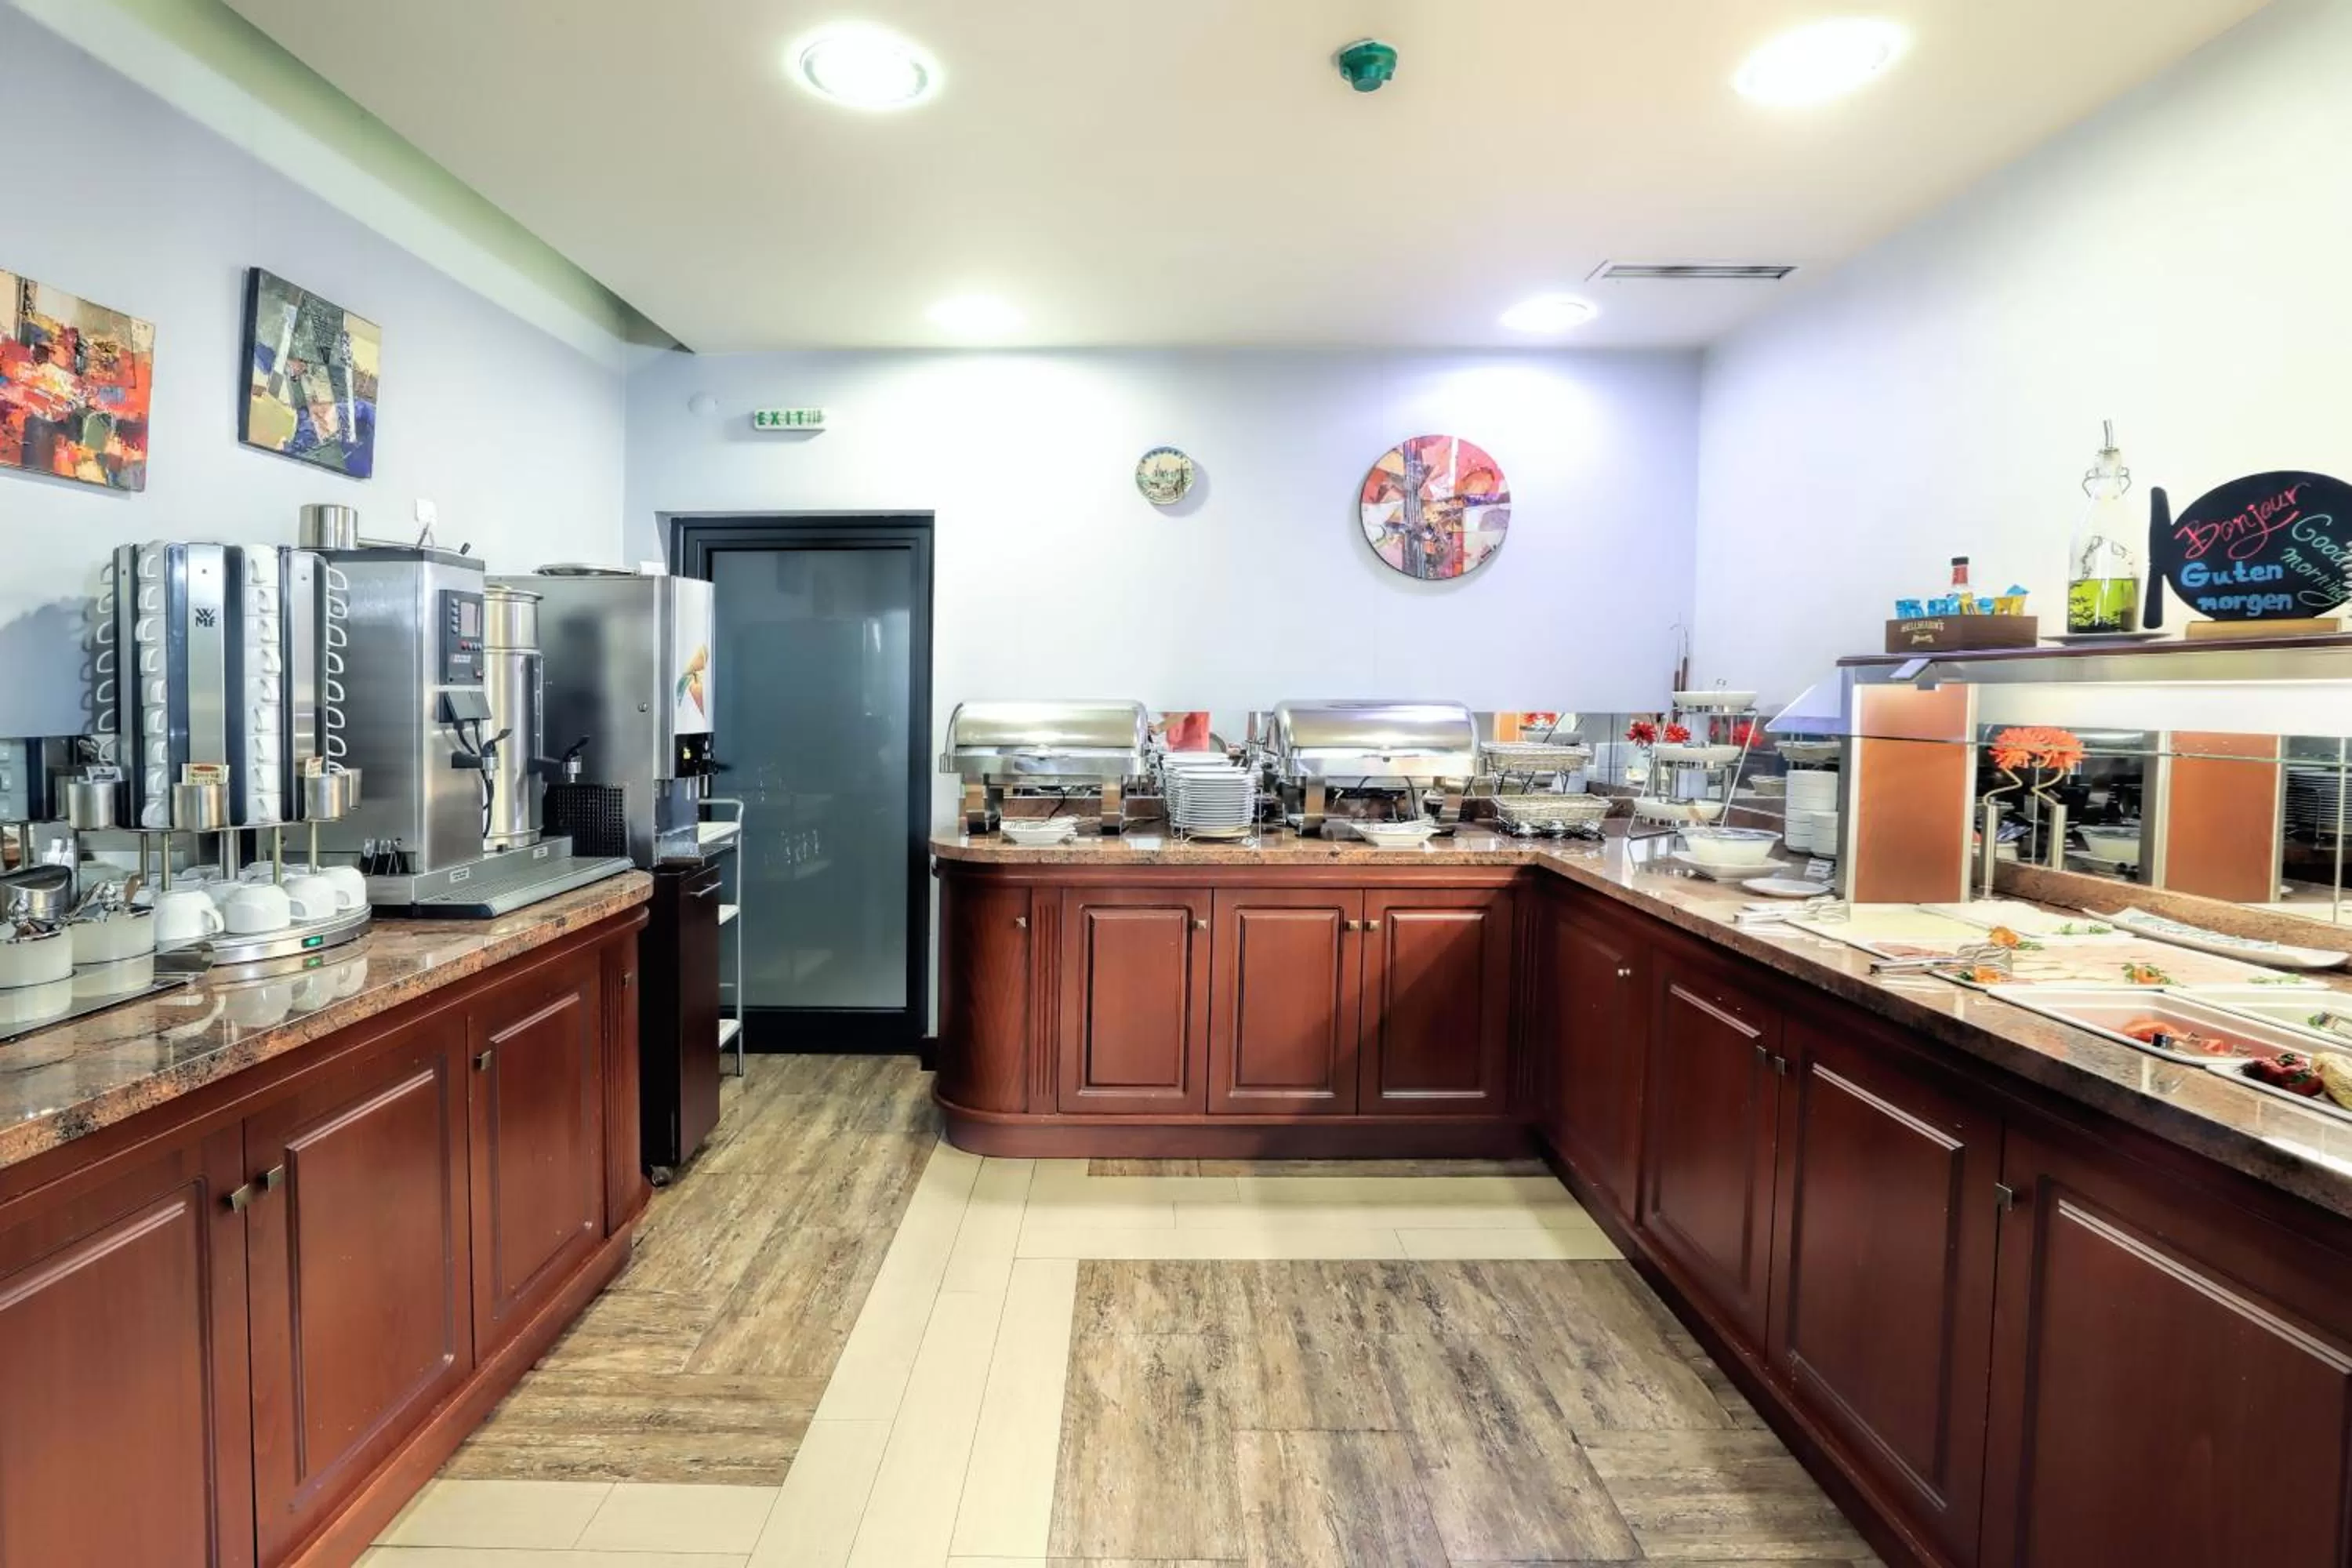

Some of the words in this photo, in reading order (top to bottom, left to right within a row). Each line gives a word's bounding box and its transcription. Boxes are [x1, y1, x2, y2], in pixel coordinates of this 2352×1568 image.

[757, 411, 804, 425] EXIT
[2174, 481, 2310, 560] Bonjour
[2180, 561, 2284, 587] Guten
